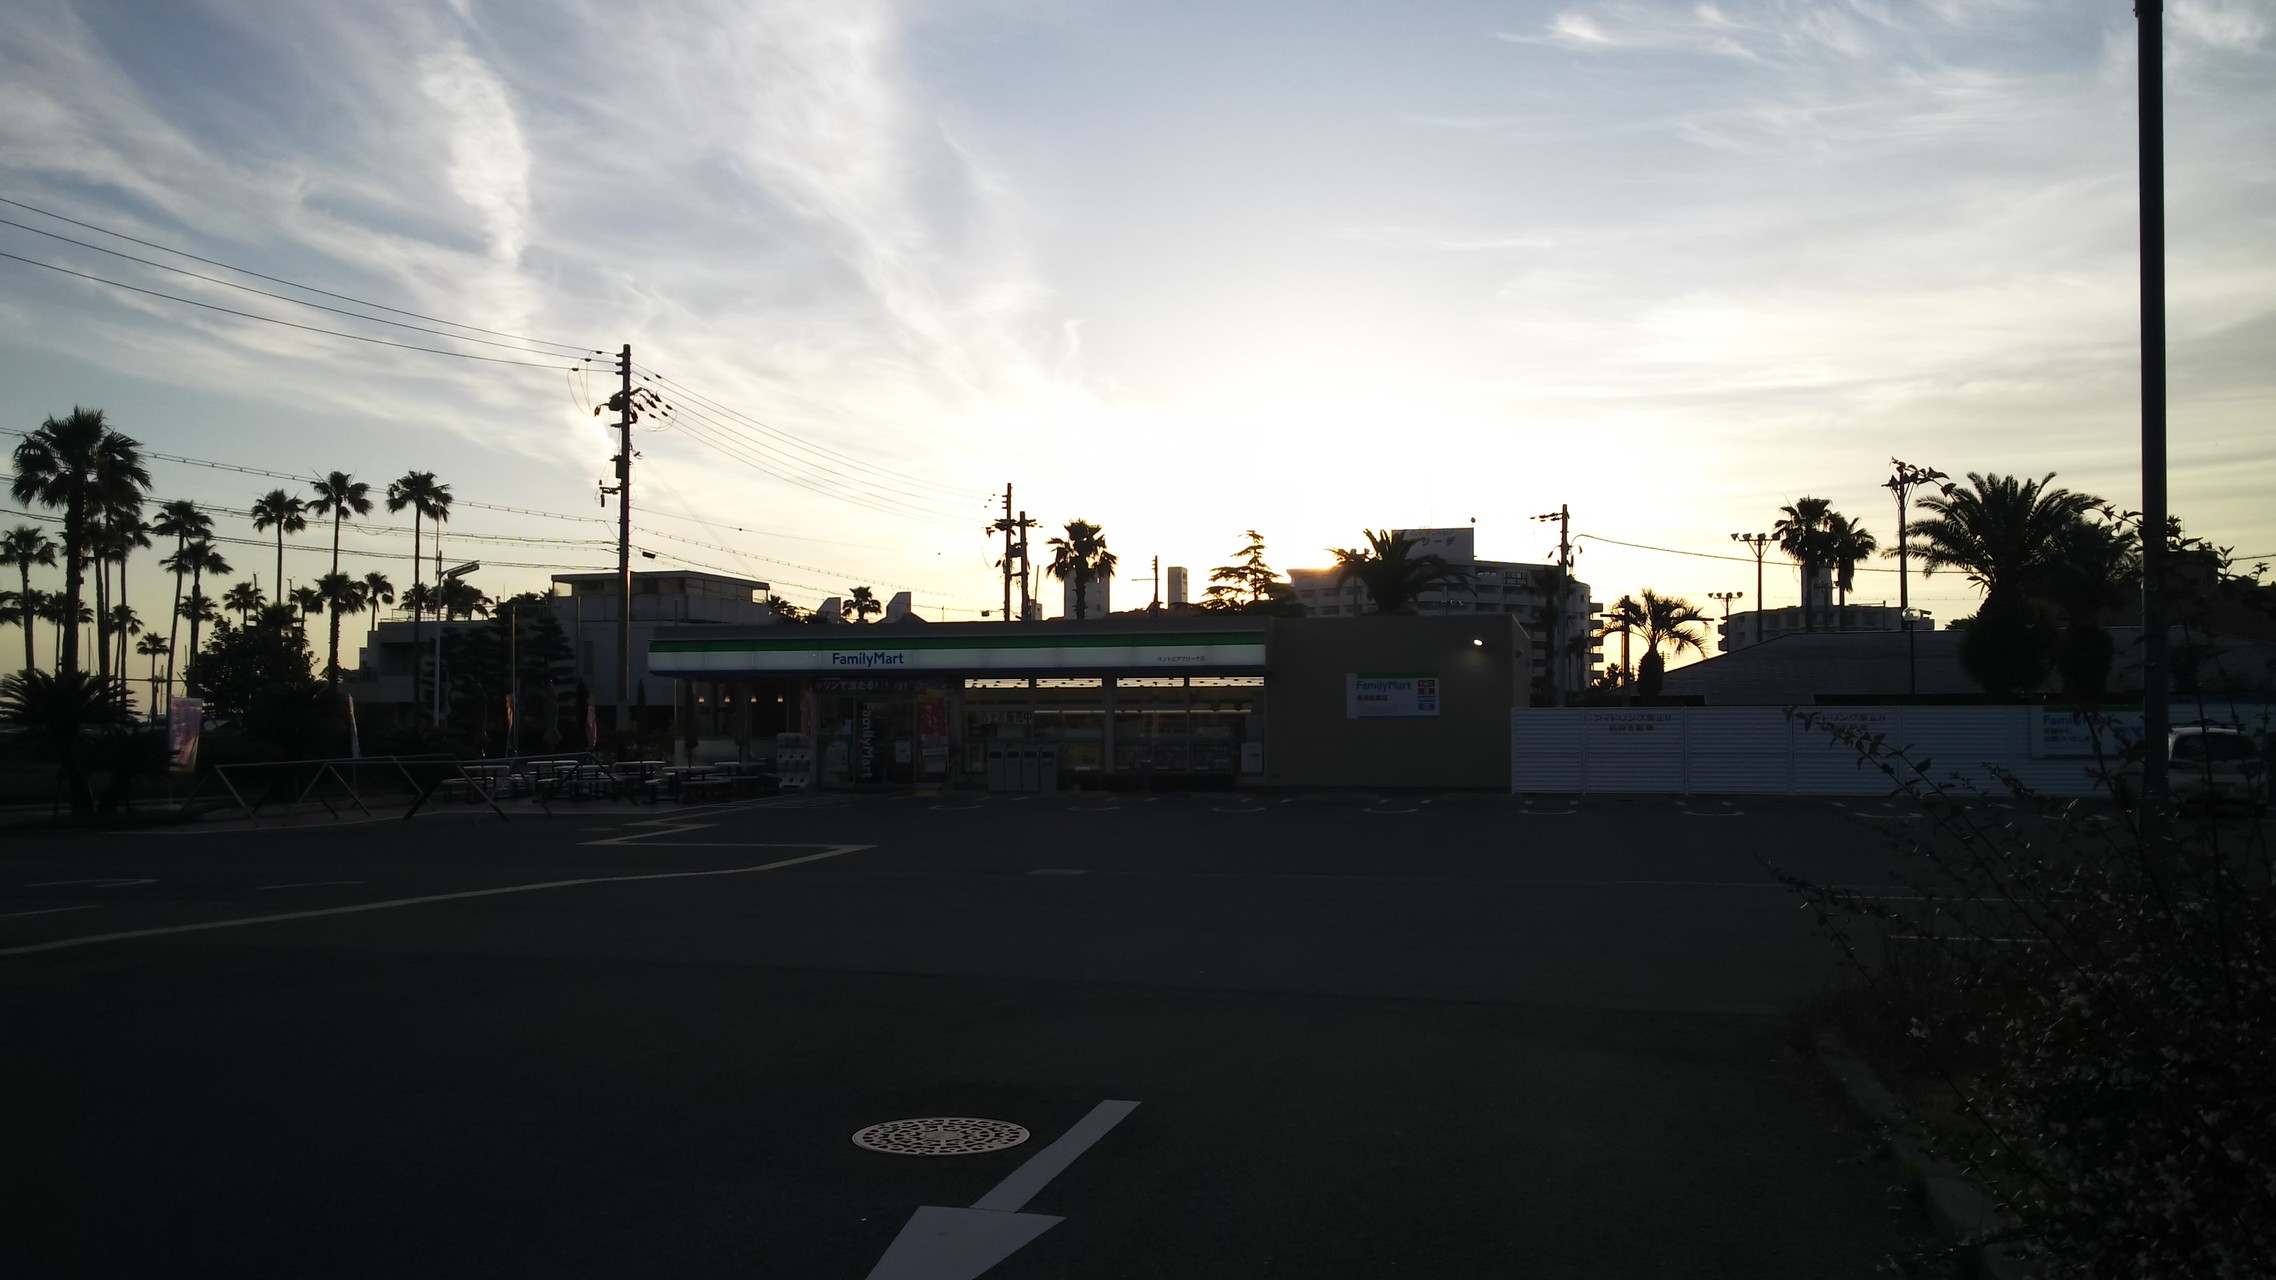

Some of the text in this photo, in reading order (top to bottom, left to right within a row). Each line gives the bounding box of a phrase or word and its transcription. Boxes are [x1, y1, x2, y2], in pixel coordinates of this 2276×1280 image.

[832, 652, 904, 667] FamilyMart
[1356, 679, 1412, 692] FamilyMart
[860, 702, 873, 778] FamilyMart
